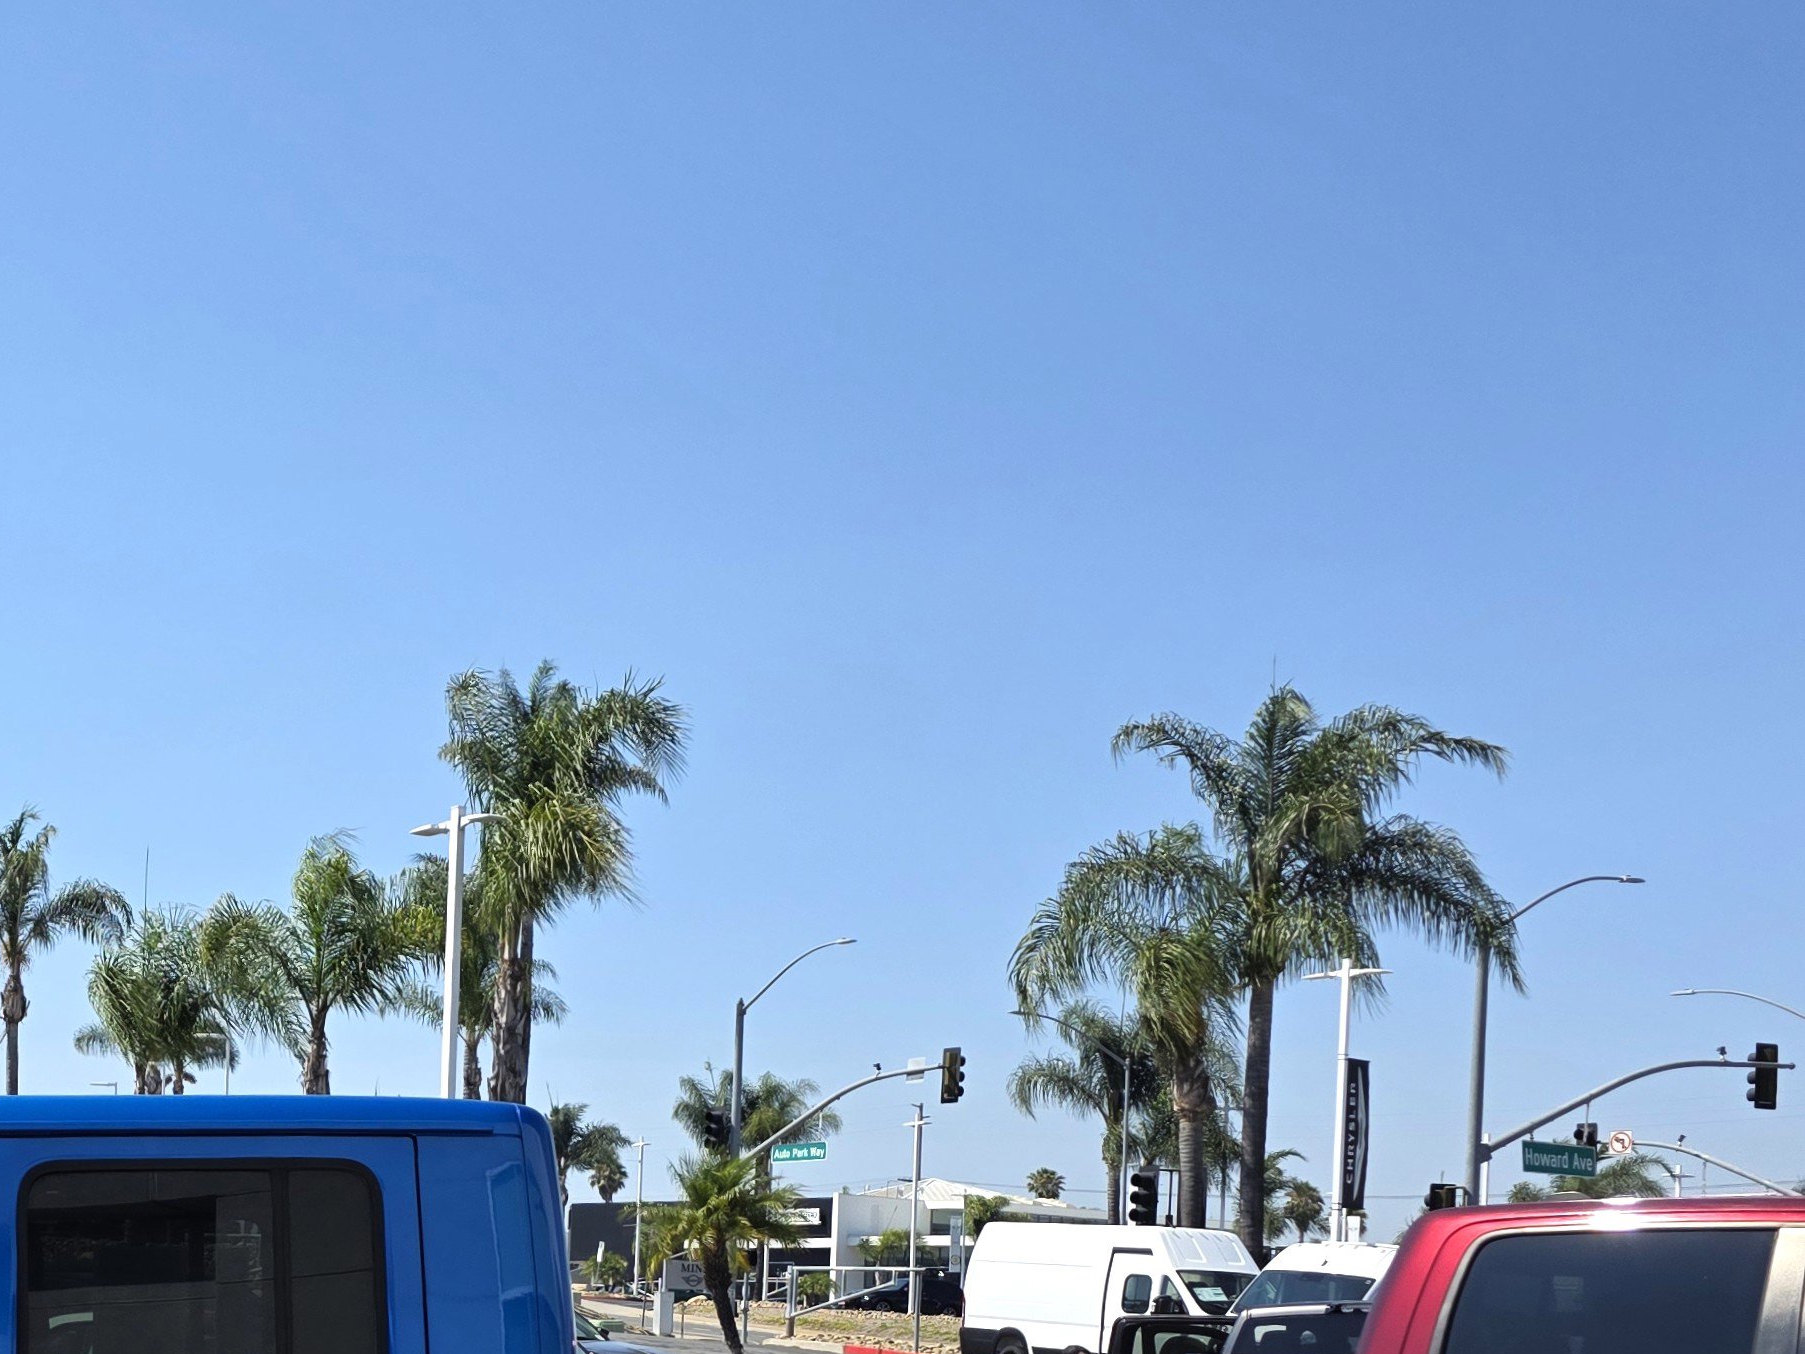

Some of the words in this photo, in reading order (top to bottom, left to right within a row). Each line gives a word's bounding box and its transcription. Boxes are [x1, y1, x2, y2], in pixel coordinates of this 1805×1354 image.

[1346, 1082, 1357, 1185] CHRYSLER
[774, 1149, 791, 1159] Auto
[792, 1148, 808, 1158] Park
[810, 1147, 825, 1158] Way
[1525, 1147, 1569, 1169] Howard
[1572, 1153, 1593, 1171] Ave
[681, 1263, 703, 1273] MIN
